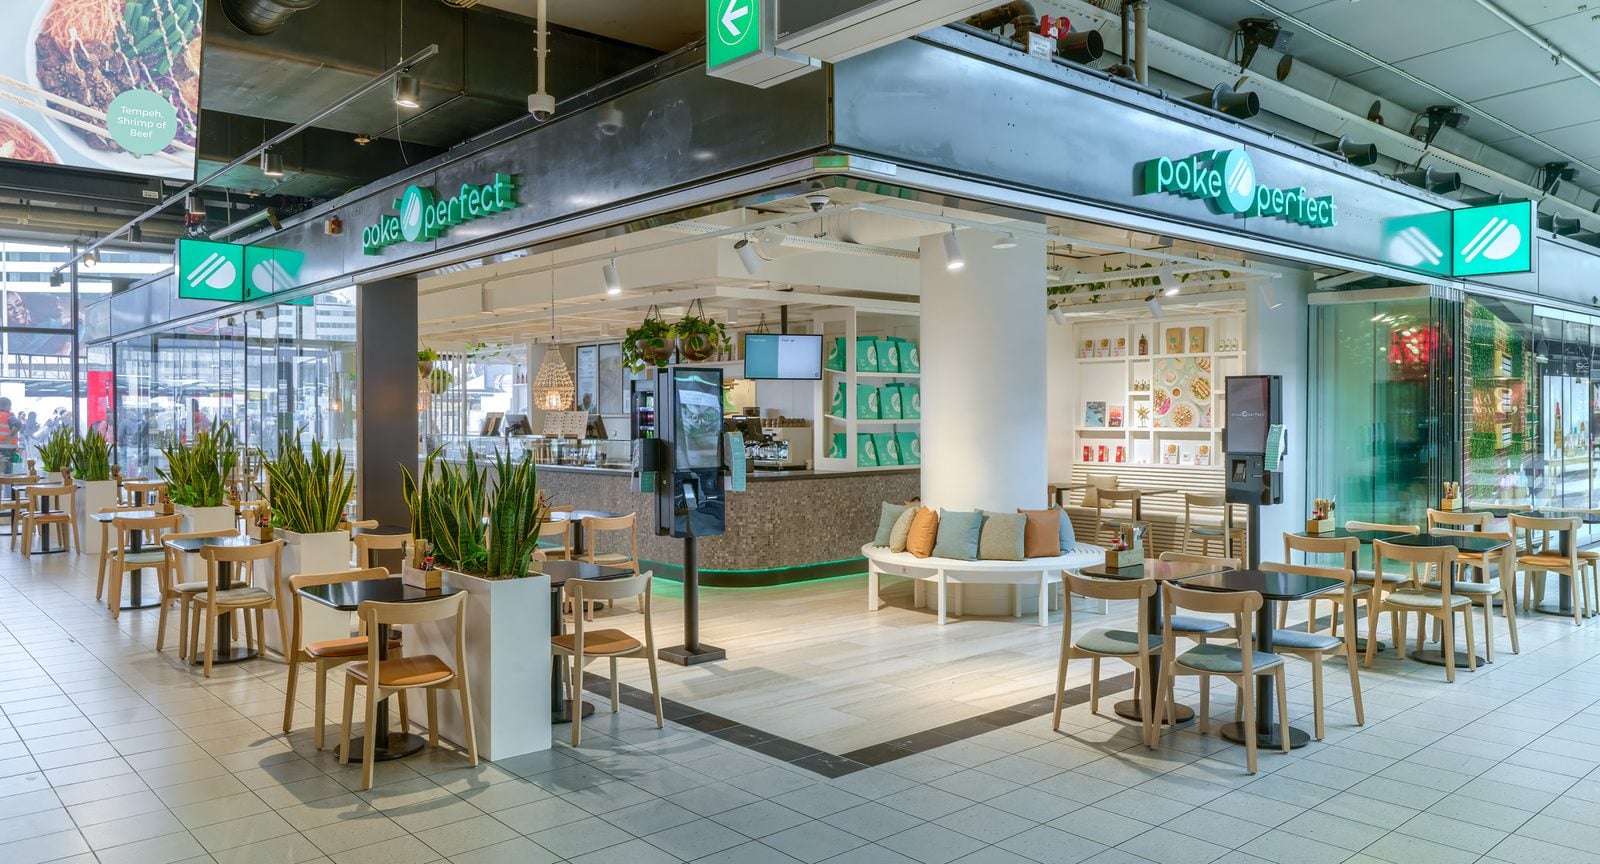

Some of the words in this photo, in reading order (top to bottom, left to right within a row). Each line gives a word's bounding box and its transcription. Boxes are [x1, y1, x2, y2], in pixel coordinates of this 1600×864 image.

[120, 105, 163, 119] Tempeh,
[117, 116, 153, 129] Shrimp
[156, 121, 167, 129] of
[130, 129, 153, 138] Beef
[424, 172, 504, 238] perfect
[1257, 184, 1338, 227] perfect
